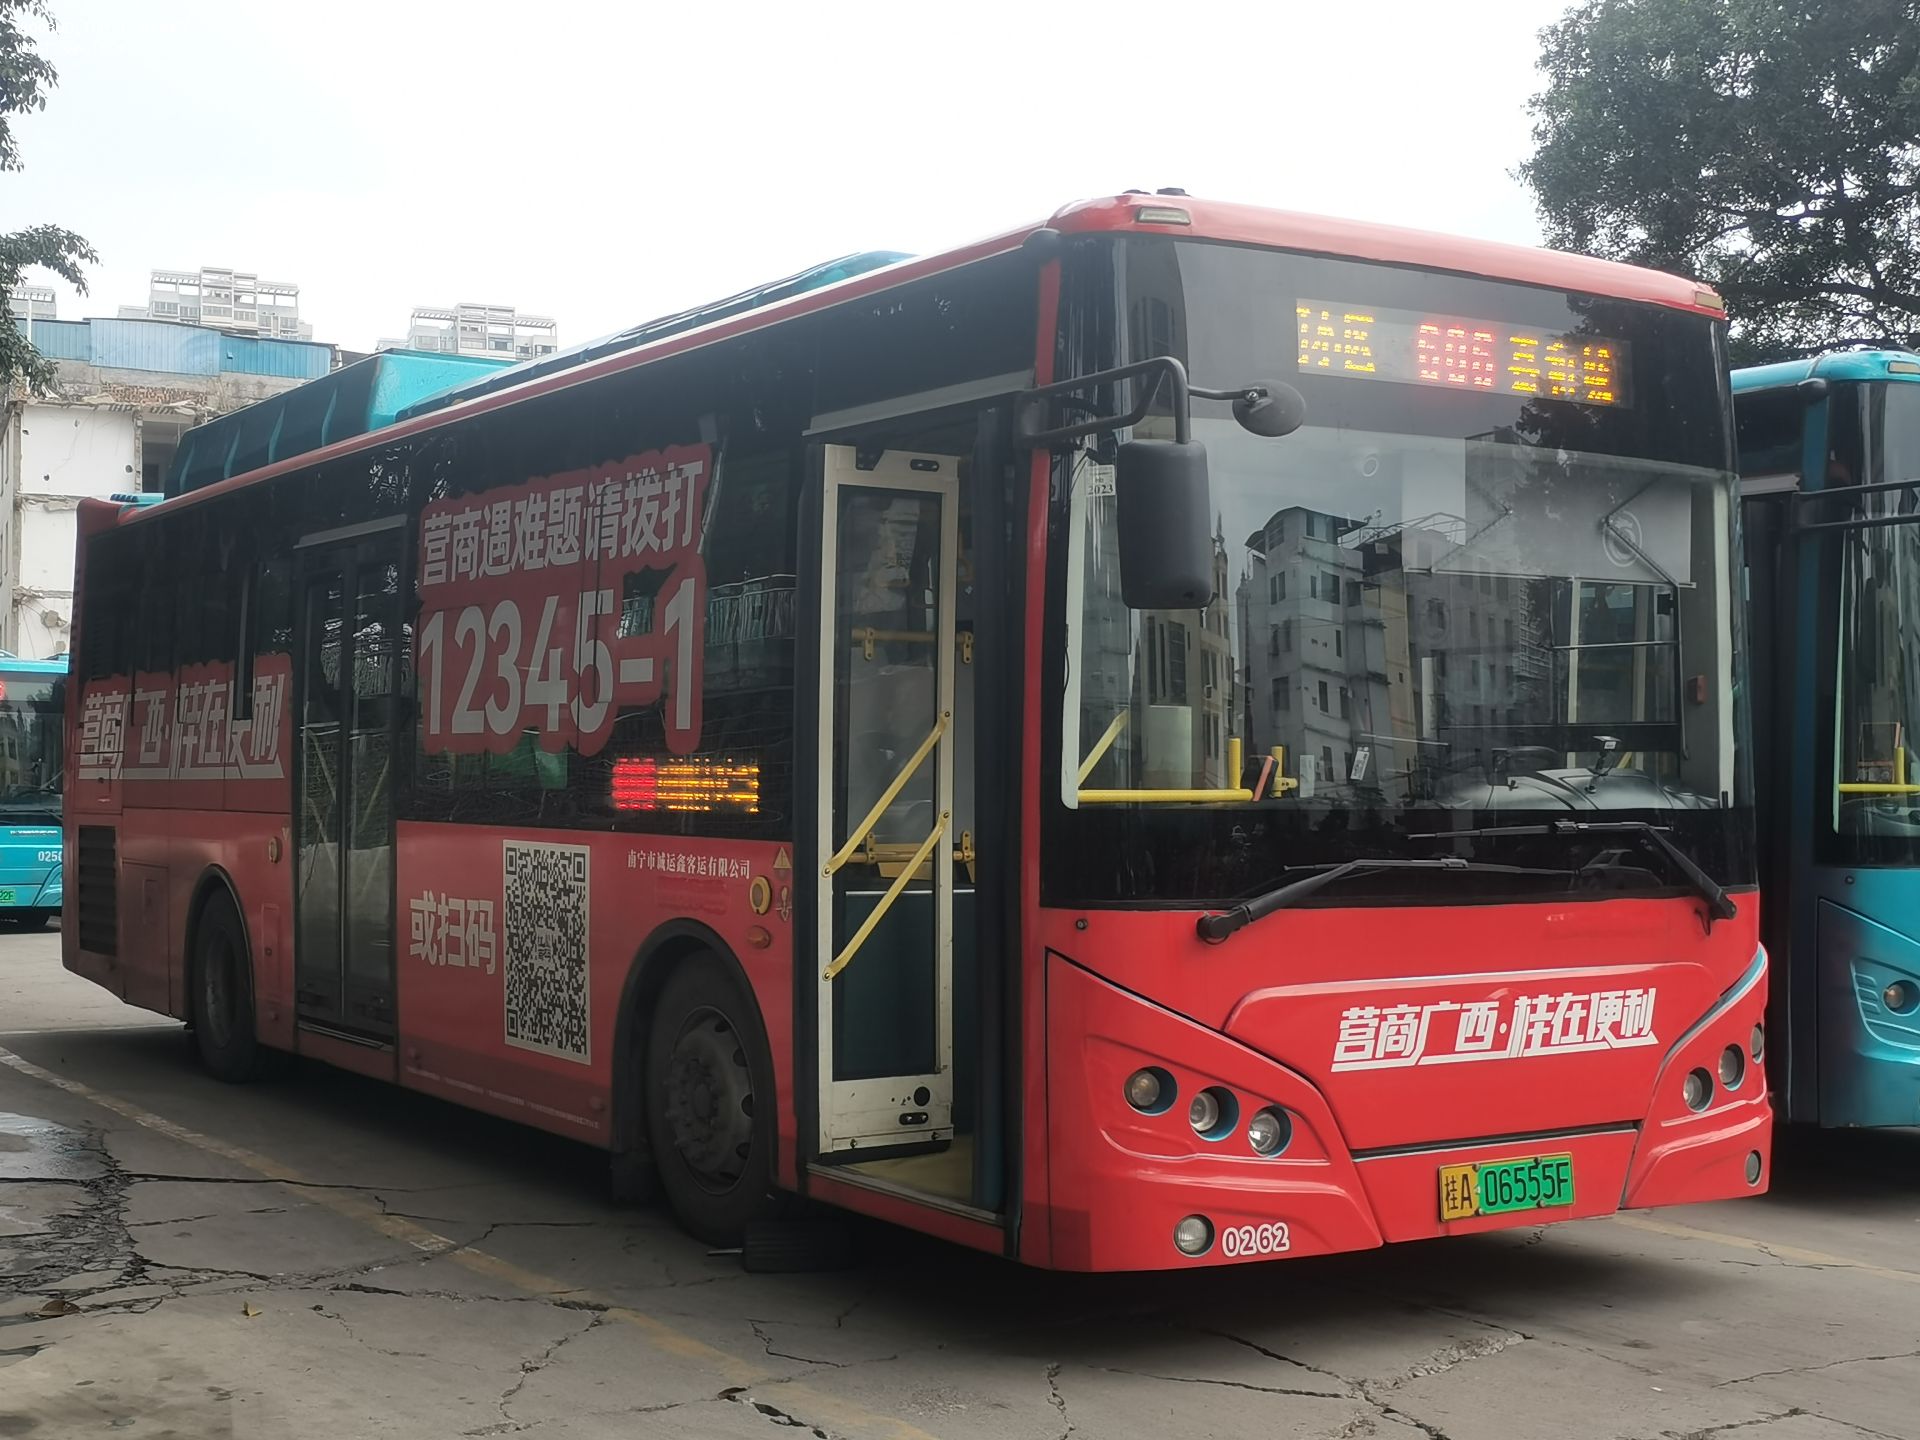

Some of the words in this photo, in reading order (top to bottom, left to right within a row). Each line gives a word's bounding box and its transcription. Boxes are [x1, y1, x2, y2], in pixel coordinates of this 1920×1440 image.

[423, 460, 703, 587] 营商遇难题请拨打
[420, 577, 695, 735] 12345-1
[409, 890, 497, 975] 或扫码
[1222, 1222, 1290, 1257] 0262
